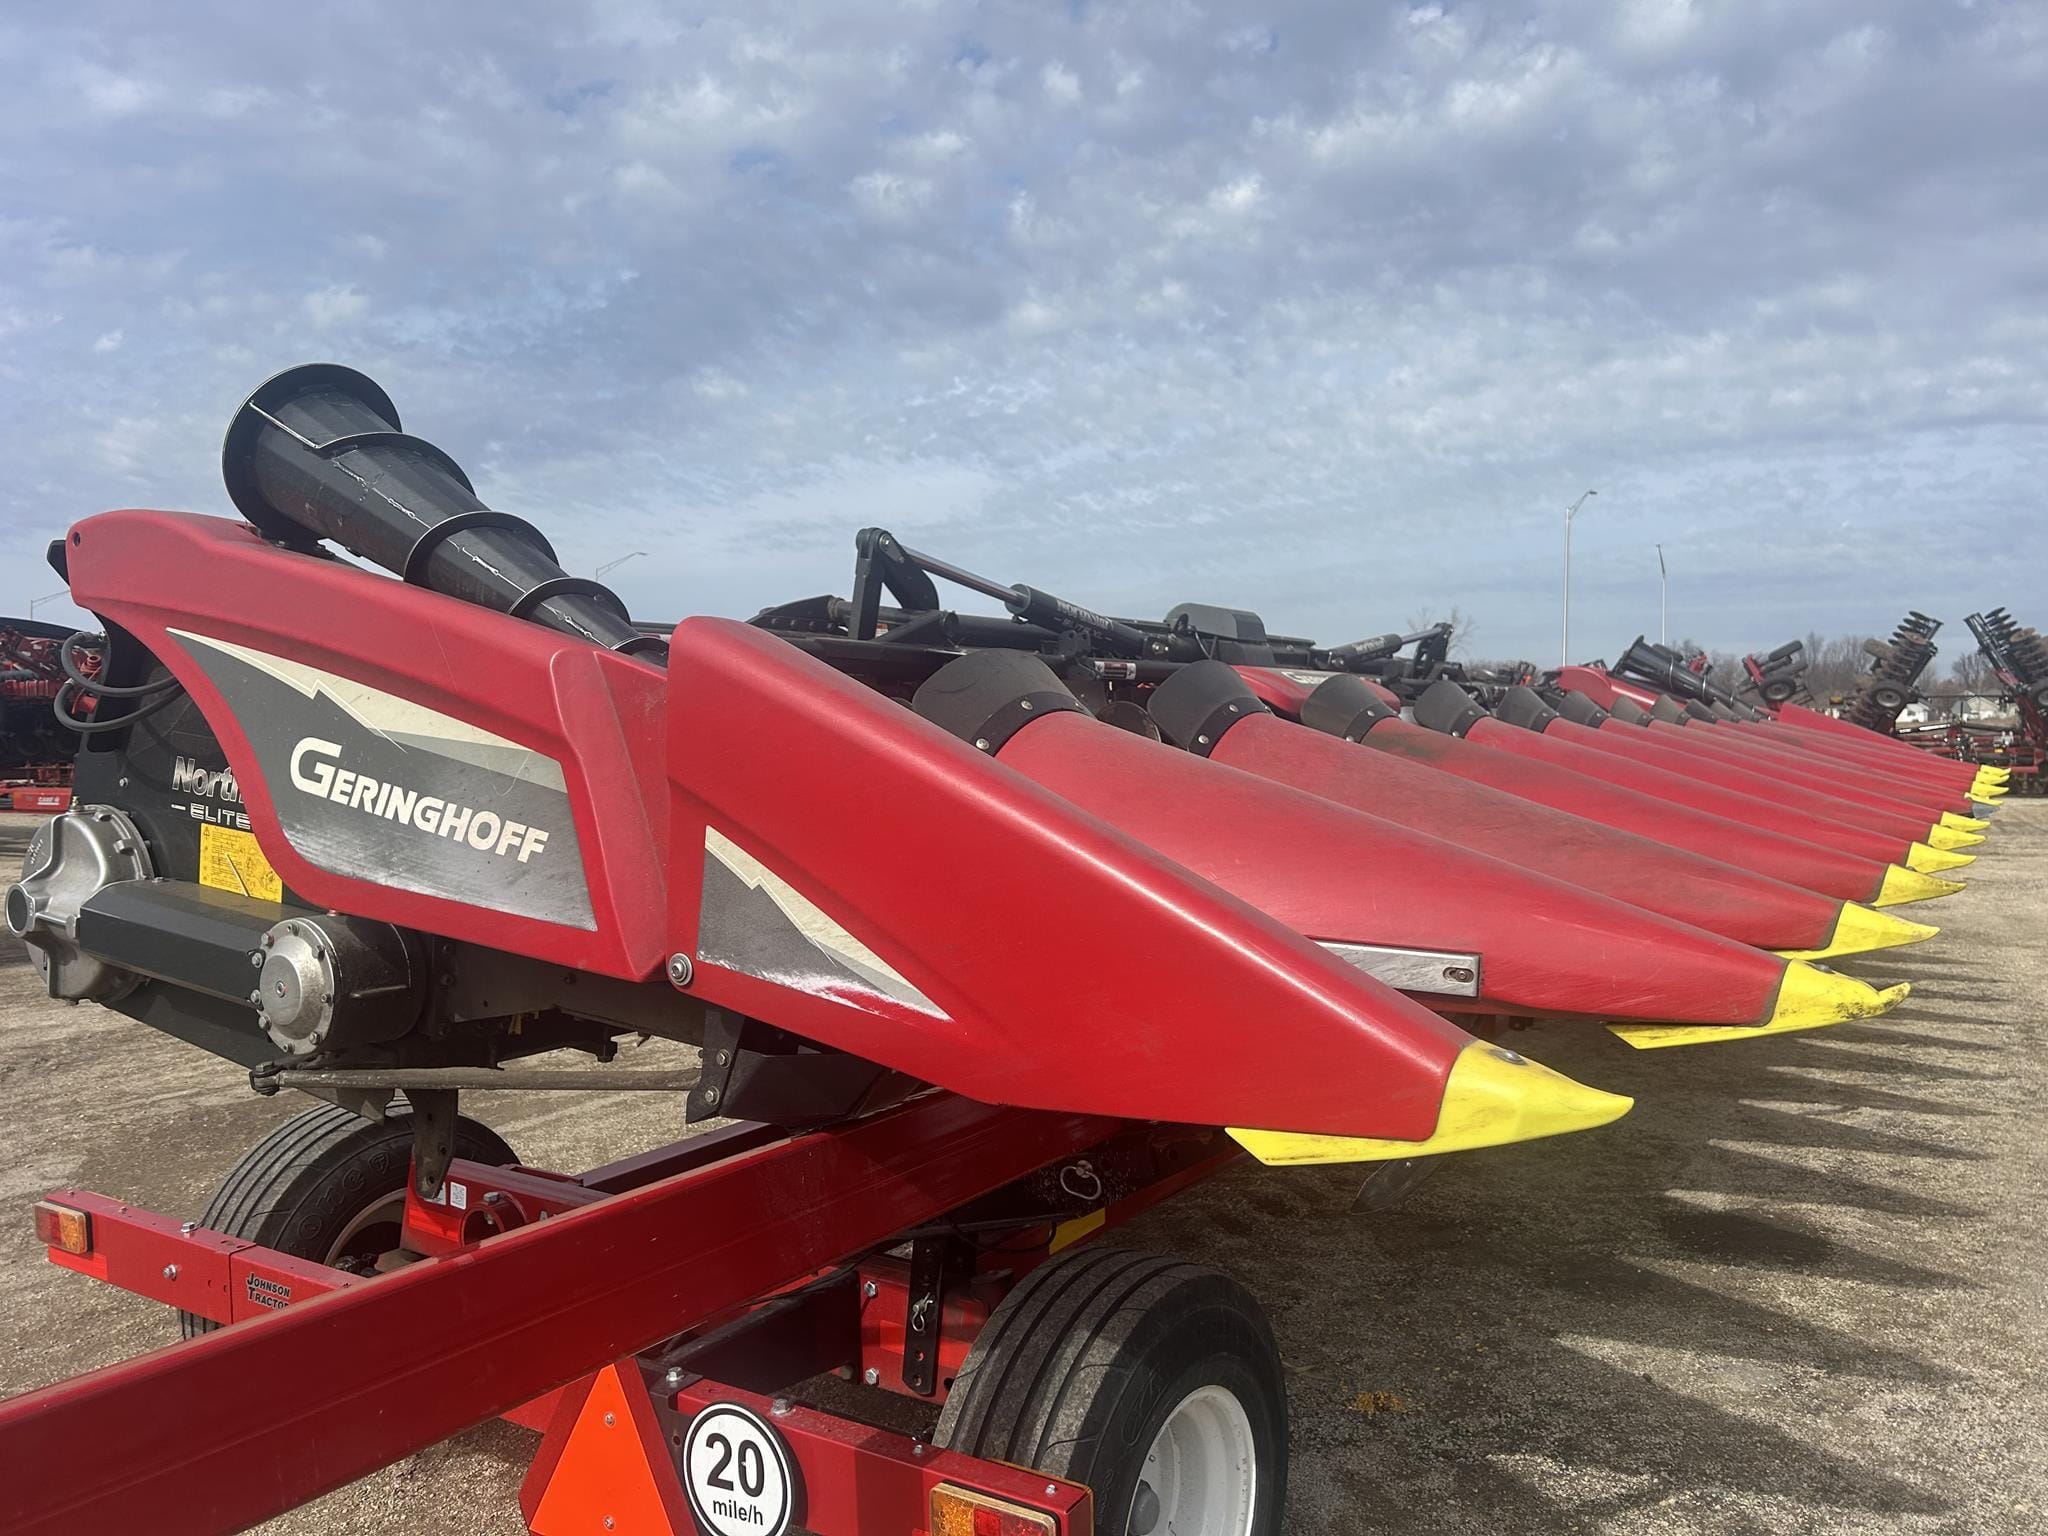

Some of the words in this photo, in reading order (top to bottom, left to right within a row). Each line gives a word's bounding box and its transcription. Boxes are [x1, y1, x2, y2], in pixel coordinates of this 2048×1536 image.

[289, 736, 550, 864] GERINGHOFF
[190, 802, 251, 830] ELITE
[246, 1272, 291, 1298] JOHNSON
[705, 1432, 765, 1498] 20
[712, 1499, 764, 1526] mile/h
